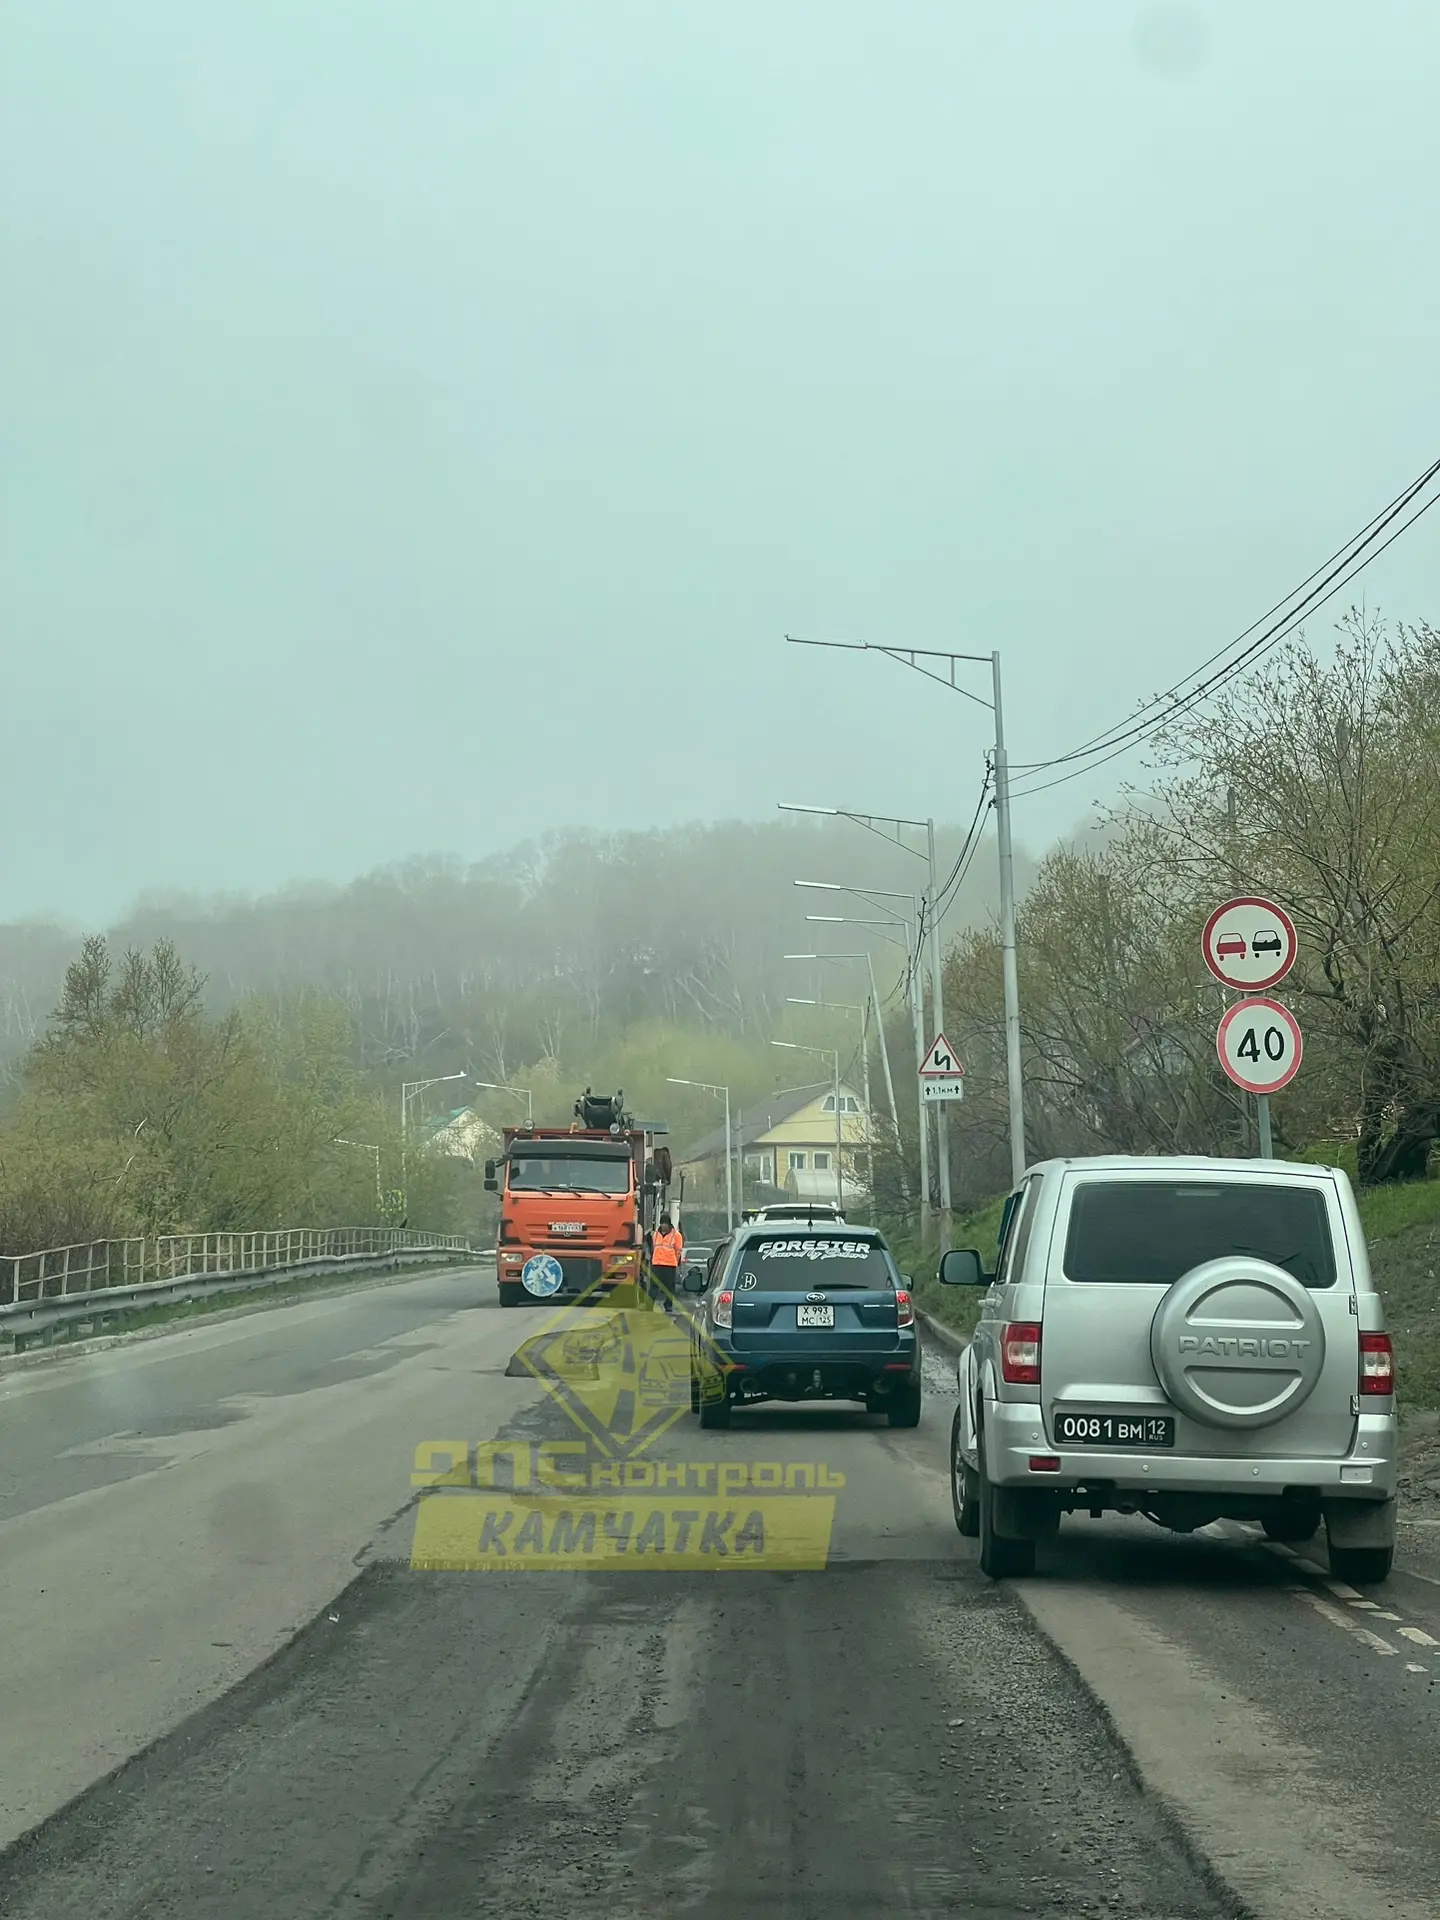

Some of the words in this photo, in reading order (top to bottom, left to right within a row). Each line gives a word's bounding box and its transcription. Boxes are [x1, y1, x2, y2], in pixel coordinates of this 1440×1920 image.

[1237, 1026, 1285, 1063] 40
[757, 1240, 871, 1254] FORESTER
[812, 1306, 828, 1315] 993
[819, 1316, 831, 1324] 125
[1178, 1335, 1311, 1359] PATRIOT
[1063, 1417, 1113, 1438] 0081
[1147, 1420, 1165, 1435] 12
